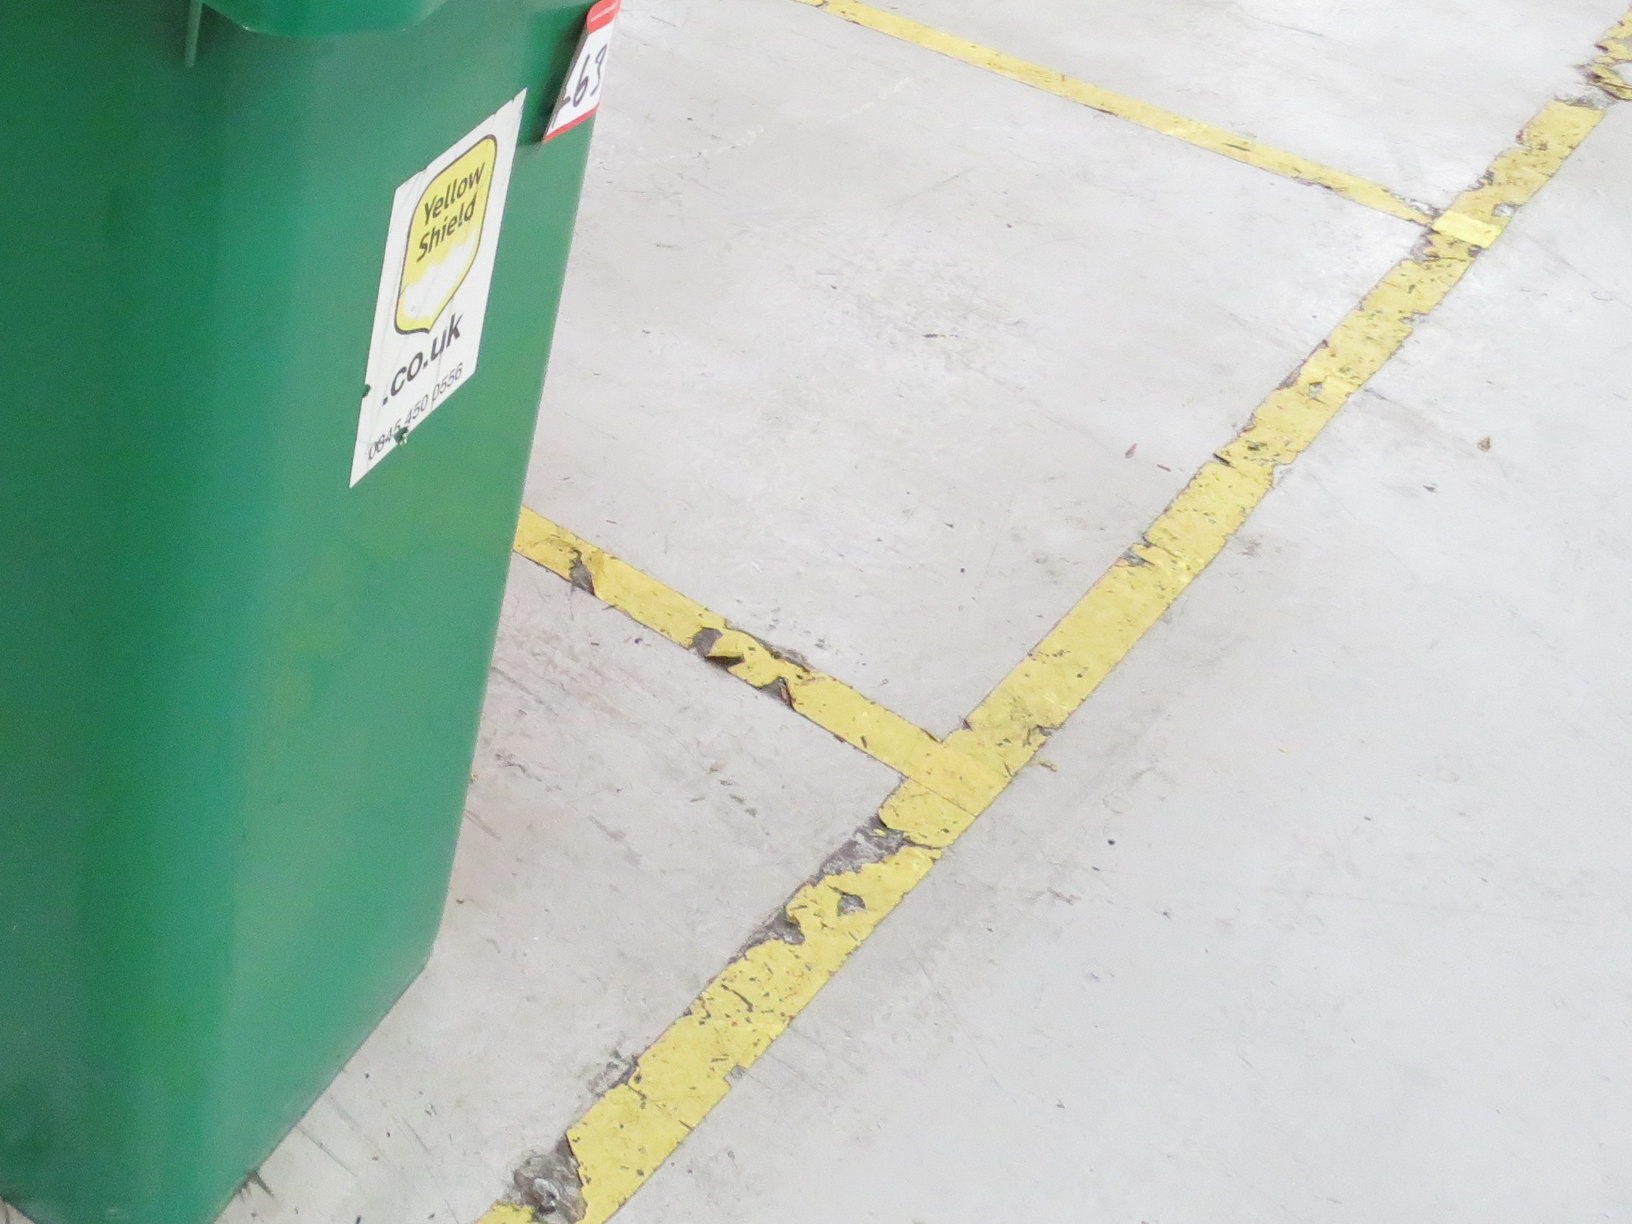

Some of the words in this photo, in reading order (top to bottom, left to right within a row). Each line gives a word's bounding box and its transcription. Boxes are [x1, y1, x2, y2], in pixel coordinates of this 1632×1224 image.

[415, 191, 478, 263] Shield
[424, 161, 486, 227] Yellow
[382, 313, 465, 406] .co.uk
[404, 393, 429, 425] 450
[432, 362, 464, 402] 0556
